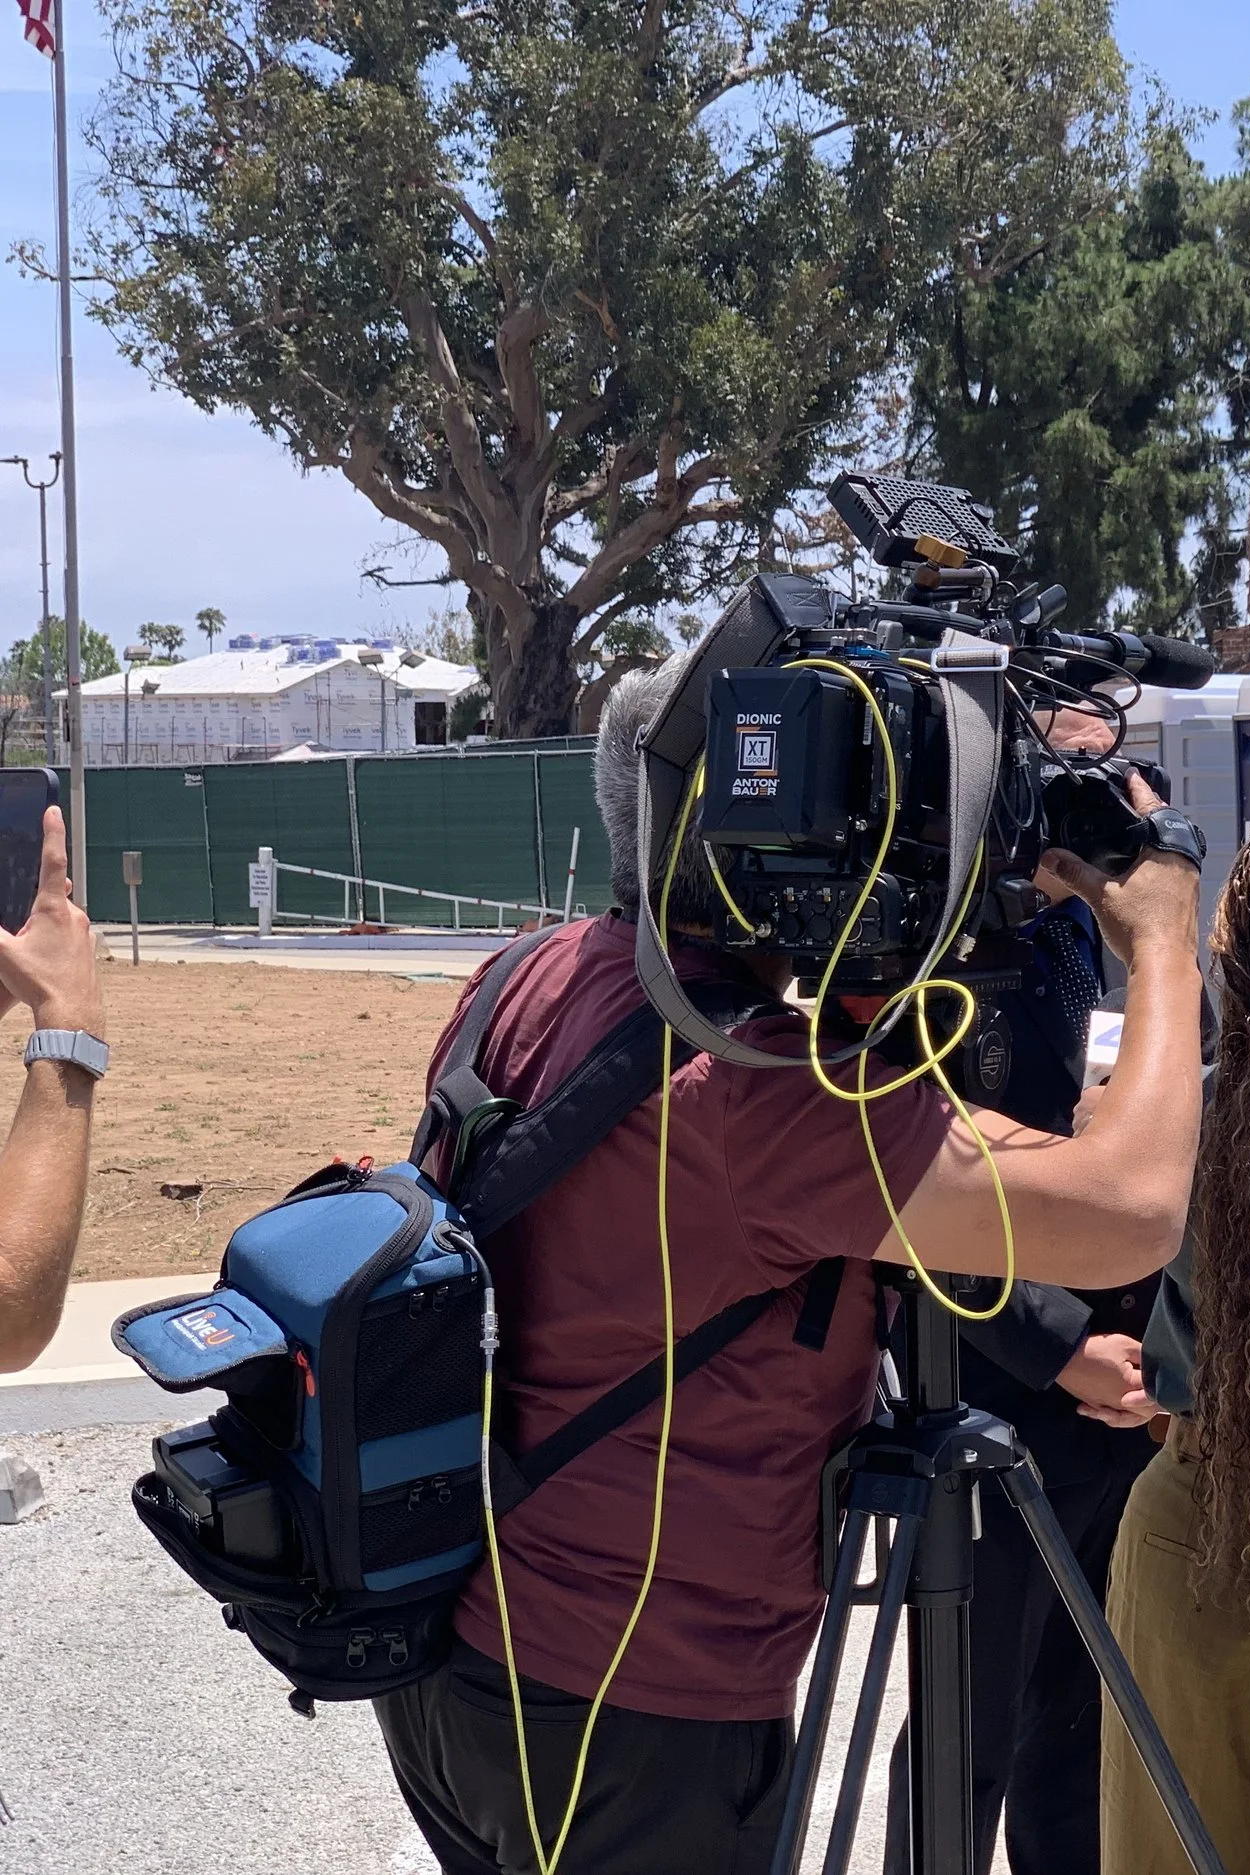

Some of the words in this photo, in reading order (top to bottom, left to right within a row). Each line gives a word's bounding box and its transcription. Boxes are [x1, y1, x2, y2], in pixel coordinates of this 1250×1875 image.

[736, 713, 782, 725] DIONIC
[747, 740, 768, 756] XT
[732, 778, 778, 787] ANTON
[731, 787, 777, 796] BAUER
